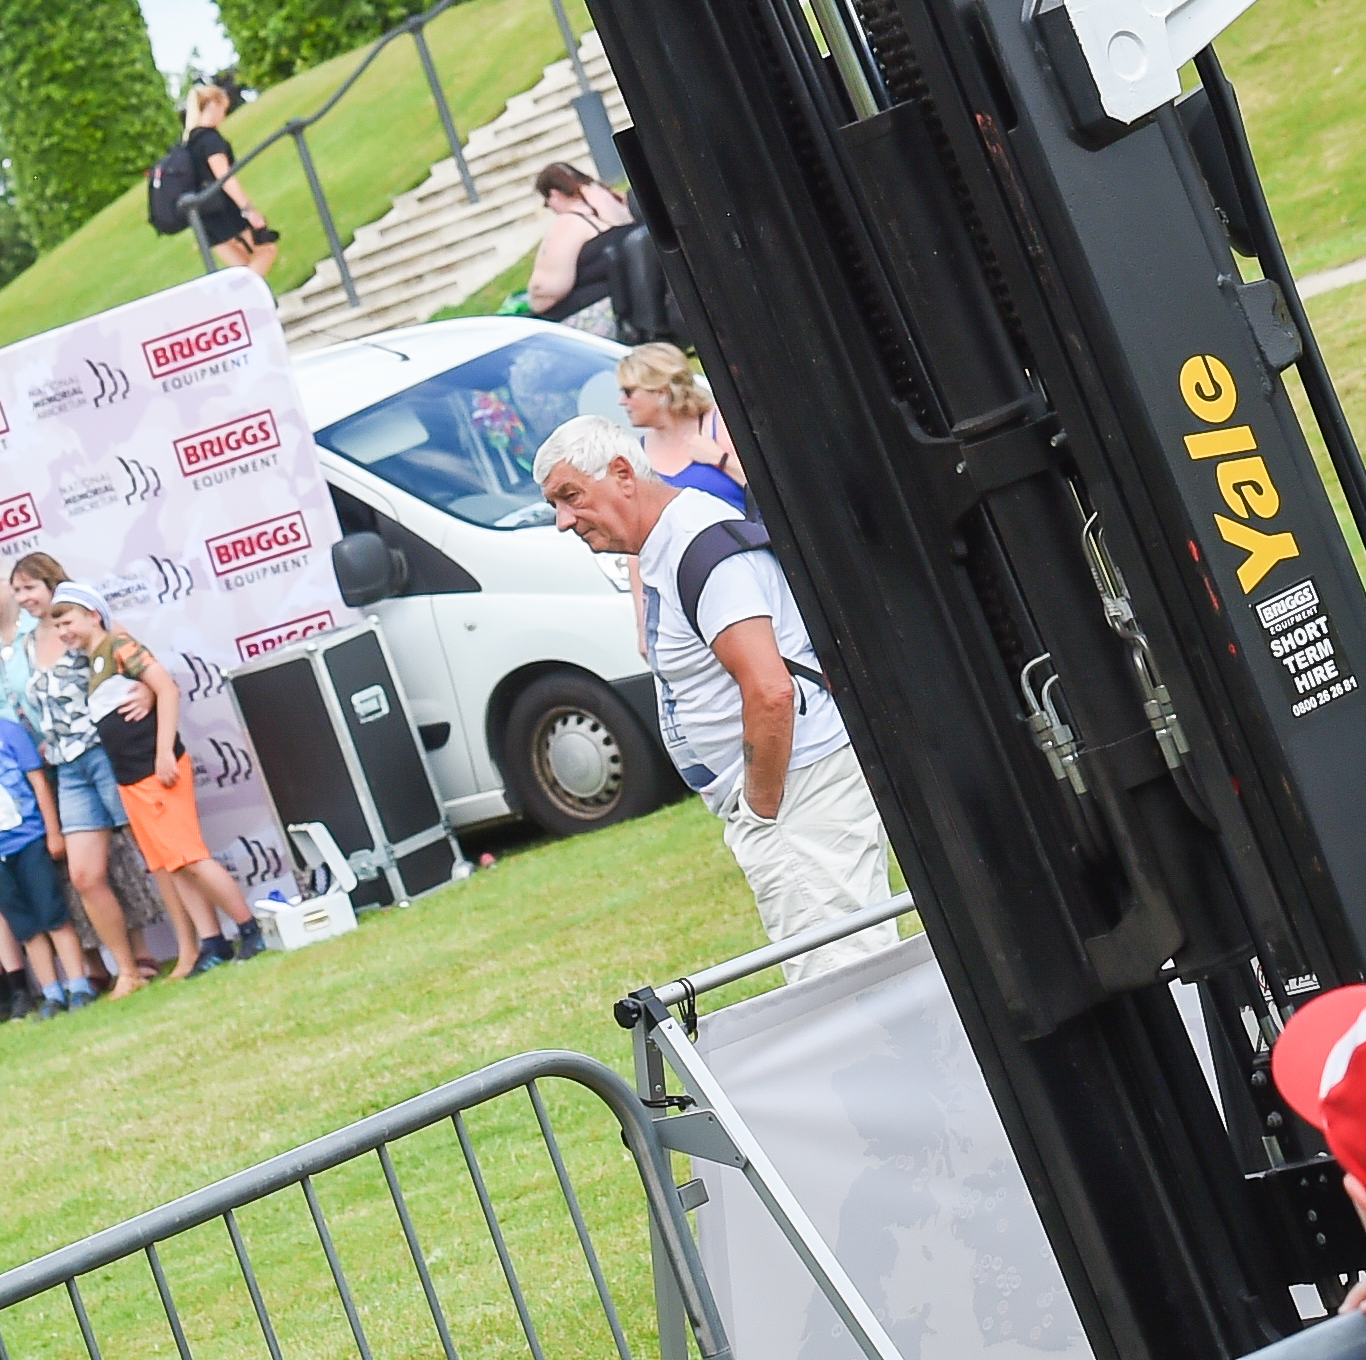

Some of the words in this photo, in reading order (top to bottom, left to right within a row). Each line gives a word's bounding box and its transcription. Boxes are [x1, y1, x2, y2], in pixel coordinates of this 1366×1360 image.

[153, 322, 242, 367] BRIGGS
[162, 353, 250, 392] EQUIPMENT
[183, 421, 271, 465] BRIGGS
[192, 454, 278, 491] EQUIPMENT
[1178, 354, 1299, 594] Yale
[215, 522, 301, 565] BRIGGS
[225, 555, 309, 591] EQUIPMENT
[1262, 587, 1313, 621] BRIGGS
[1269, 606, 1318, 635] EQUIPMENT
[1270, 615, 1328, 657] SHORT
[1282, 638, 1335, 673] TERM
[1292, 696, 1317, 717] 0800
[1316, 689, 1331, 705] 26
[1330, 683, 1344, 699] 26
[1343, 675, 1358, 692] 81
[1293, 659, 1339, 694] HIRE
